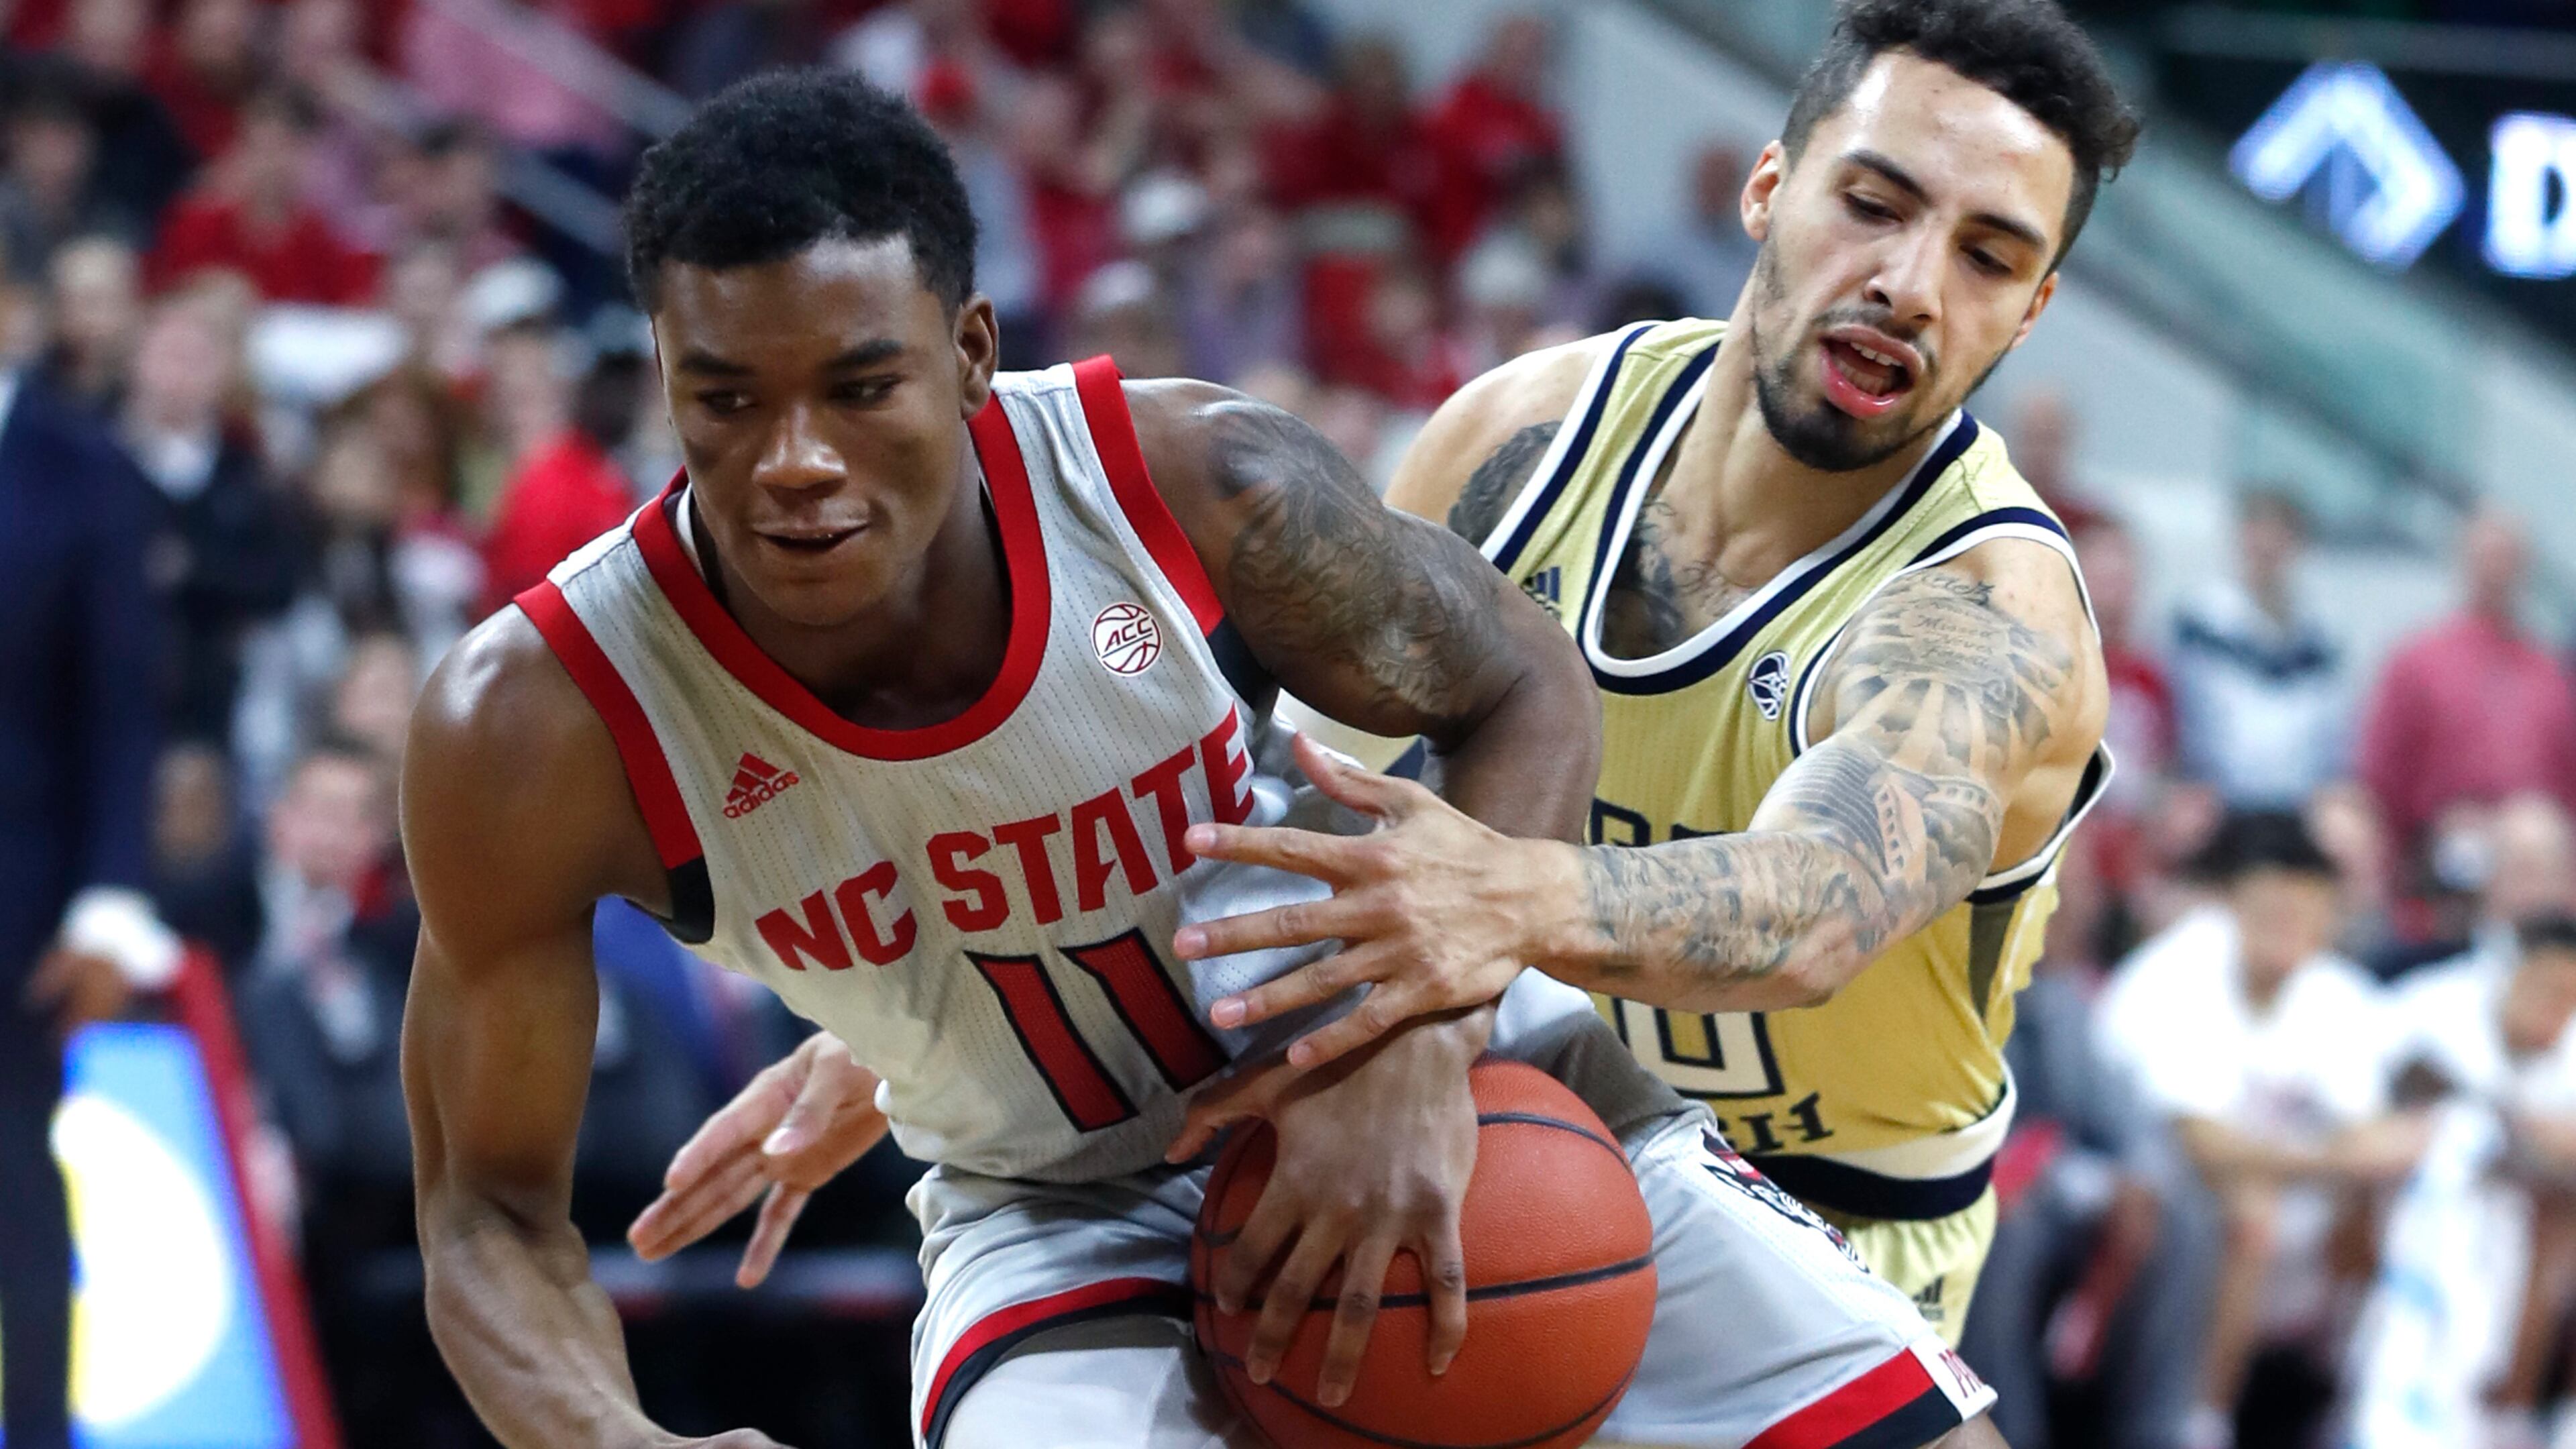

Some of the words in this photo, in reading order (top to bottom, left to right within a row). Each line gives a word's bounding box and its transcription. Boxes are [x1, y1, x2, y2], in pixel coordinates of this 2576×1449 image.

[1104, 614, 1152, 652] ACC
[723, 771, 799, 818] adidas
[755, 861, 918, 971] NC
[926, 701, 1255, 932] STATE
[963, 926, 1234, 1134] 11
